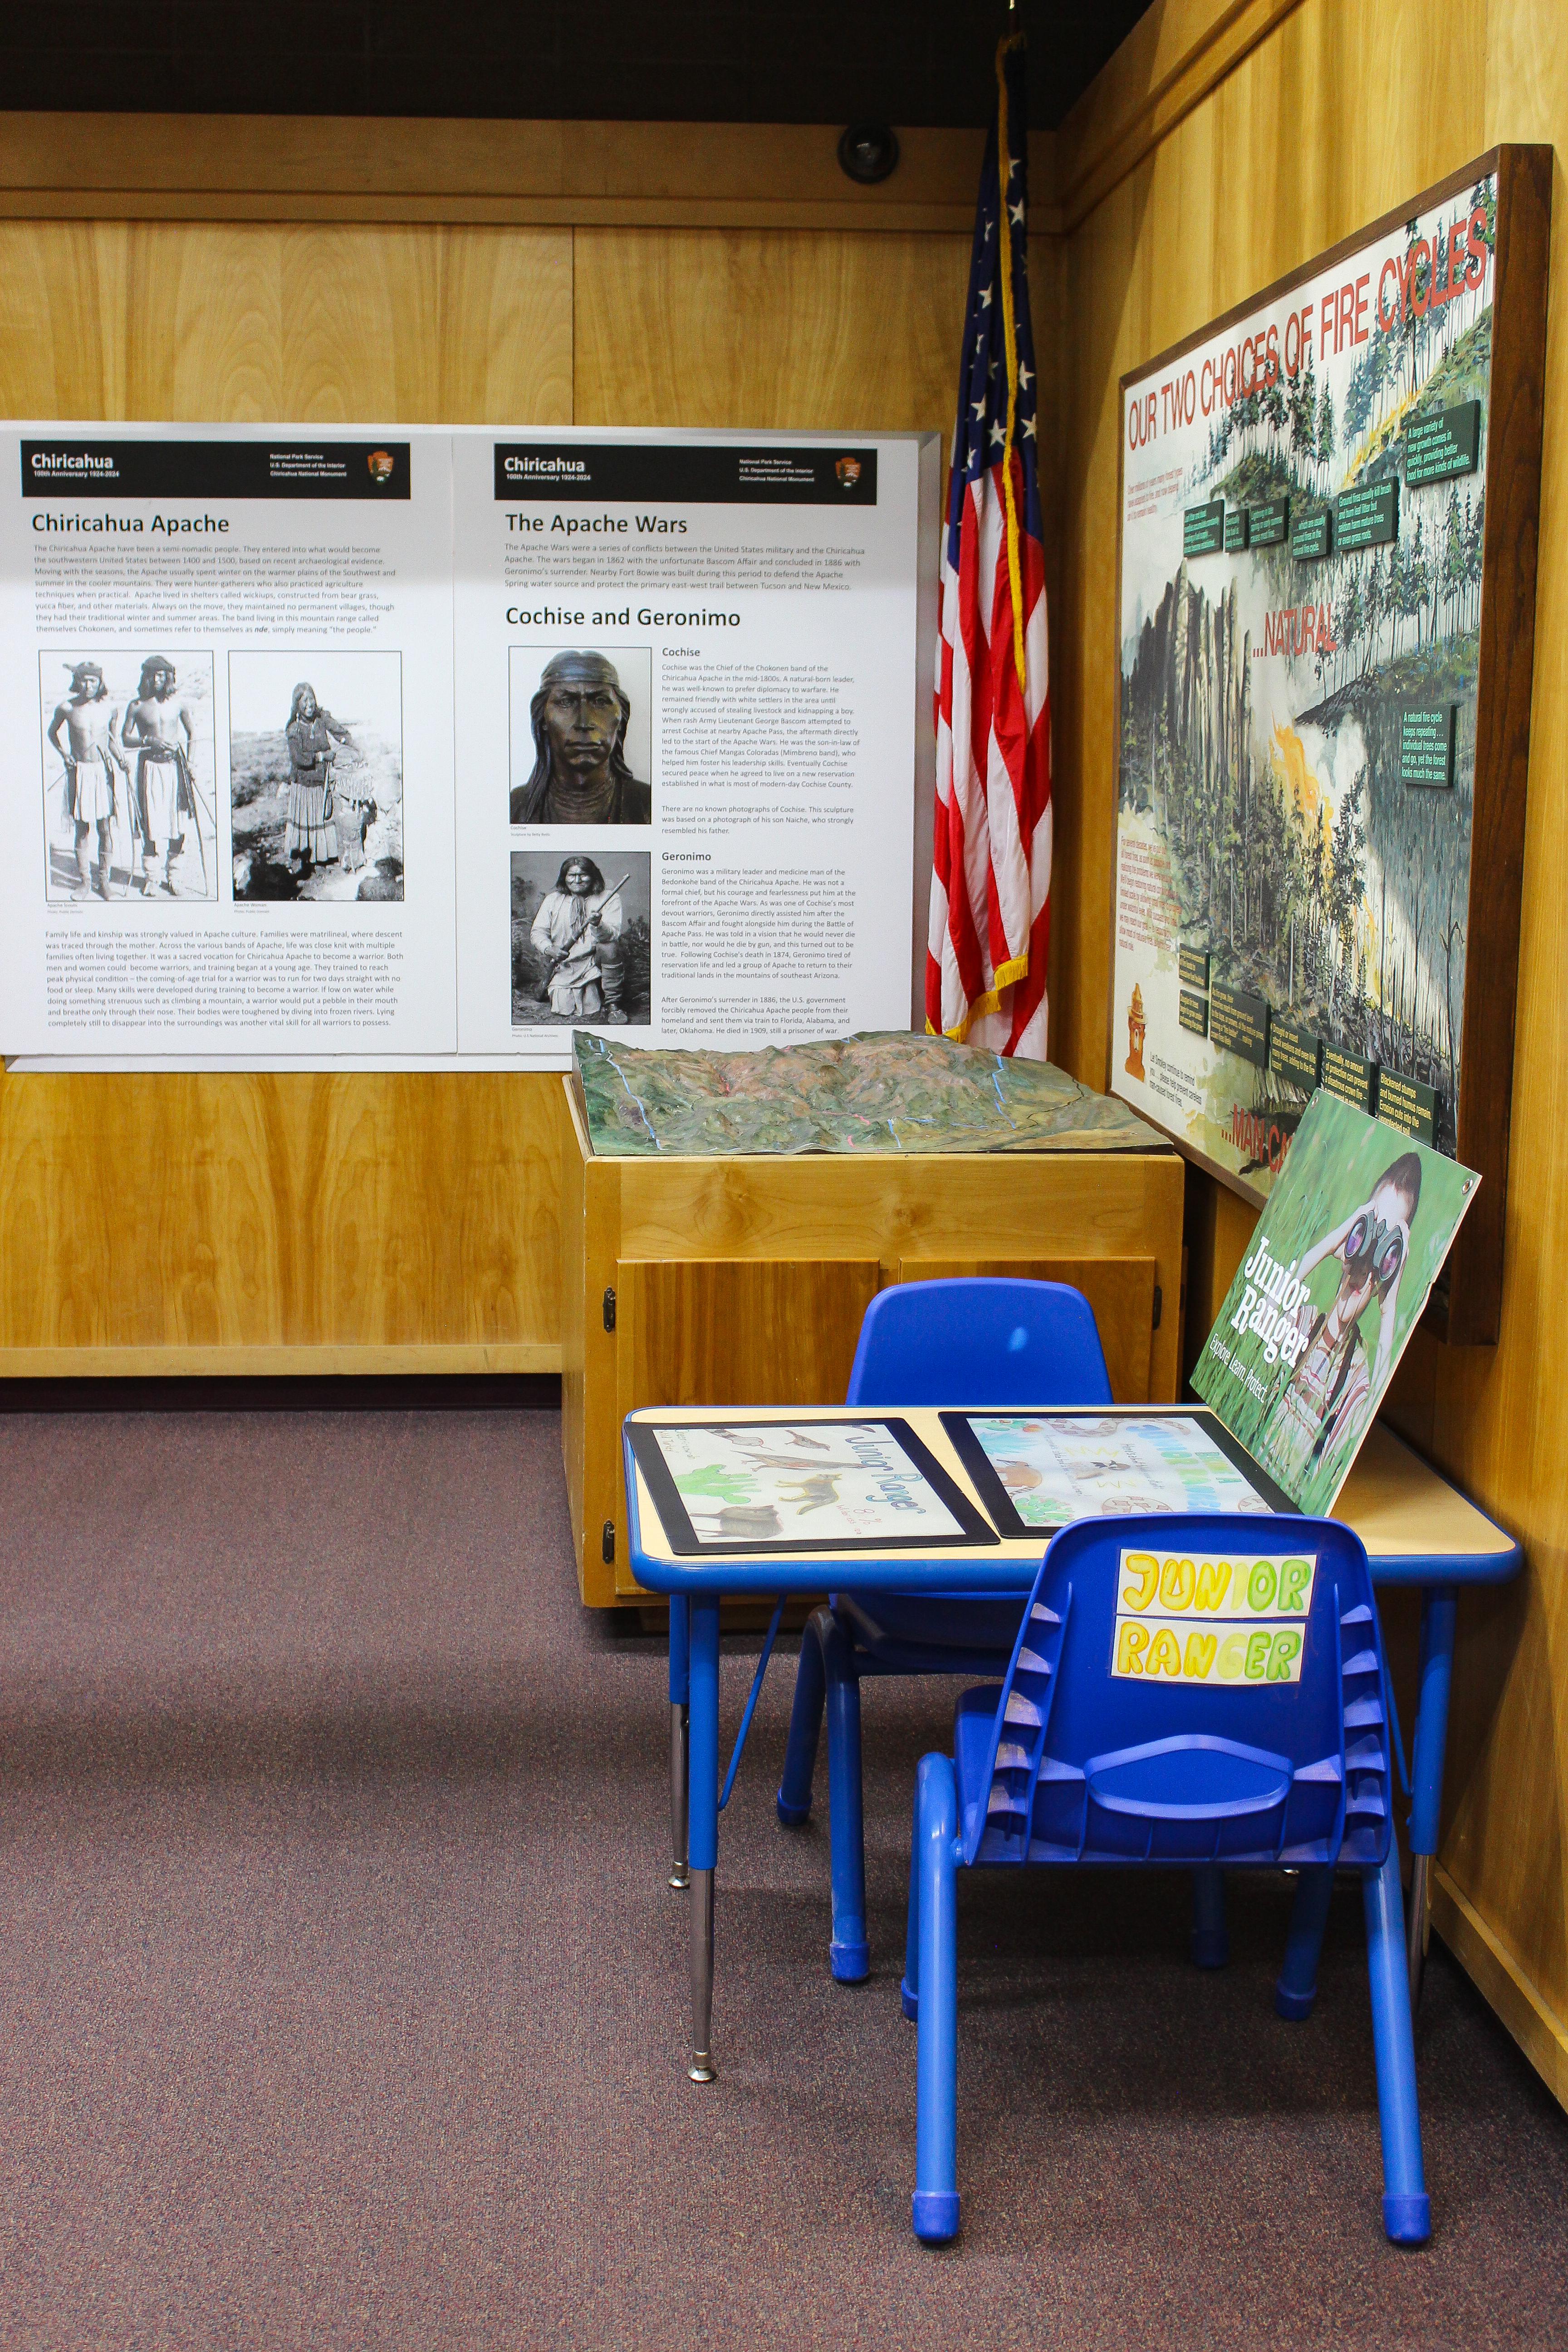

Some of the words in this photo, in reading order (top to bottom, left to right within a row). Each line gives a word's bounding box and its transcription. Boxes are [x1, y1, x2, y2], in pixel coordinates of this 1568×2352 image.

[1129, 391, 1157, 451] OUR
[1160, 370, 1196, 434] TWO
[1200, 324, 1278, 416] CHOICES
[1284, 305, 1313, 377] OF
[1320, 273, 1370, 361] FIRE
[1377, 207, 1487, 333] CYCLES
[1408, 428, 1412, 439] A
[1412, 426, 1423, 438] large
[1439, 417, 1444, 429] of
[31, 453, 113, 469] Chiricahua
[504, 456, 585, 472] Chiricahua
[1423, 448, 1443, 464] providing
[1444, 444, 1458, 456] better
[1435, 461, 1446, 473] kinds
[32, 513, 143, 532] Chiricahua
[150, 514, 229, 536] Apache
[505, 512, 544, 531] The
[550, 514, 628, 536] Apache
[635, 515, 687, 533] Wars
[506, 606, 584, 625] Cochise
[592, 607, 629, 625] and
[637, 608, 740, 626] Geronimo
[662, 647, 700, 657] Cochise
[1403, 712, 1407, 722] A
[1408, 712, 1422, 722] natural
[1431, 711, 1442, 724] cycle
[1403, 726, 1416, 738] keeps
[1402, 740, 1422, 750] individual
[1423, 741, 1434, 751] trees
[1435, 742, 1447, 751] come
[1433, 755, 1446, 765] forest
[1401, 767, 1412, 778] looks
[1413, 768, 1425, 778] much
[662, 852, 711, 861] Geronimo
[45, 931, 68, 939] Family
[98, 930, 122, 939] kinship
[140, 931, 168, 939] strongly
[203, 930, 230, 939] Apache
[1345, 1059, 1350, 1068] no
[1350, 1061, 1364, 1074] amount
[1354, 1076, 1368, 1089] prevent
[1380, 1073, 1401, 1091] Blackened
[1401, 1083, 1416, 1099] stumps
[1379, 1099, 1394, 1115] Erosion
[1395, 1109, 1403, 1120] cuts
[1388, 1090, 1402, 1105] burned
[1402, 1097, 1416, 1112] humus
[1243, 1235, 1311, 1318] Junior
[1230, 1284, 1310, 1369] Ranger
[845, 1436, 894, 1471] Junior
[866, 1473, 926, 1514] Ranger
[1122, 1553, 1312, 1612] JUNIOR
[1117, 1622, 1302, 1681] RANGER
